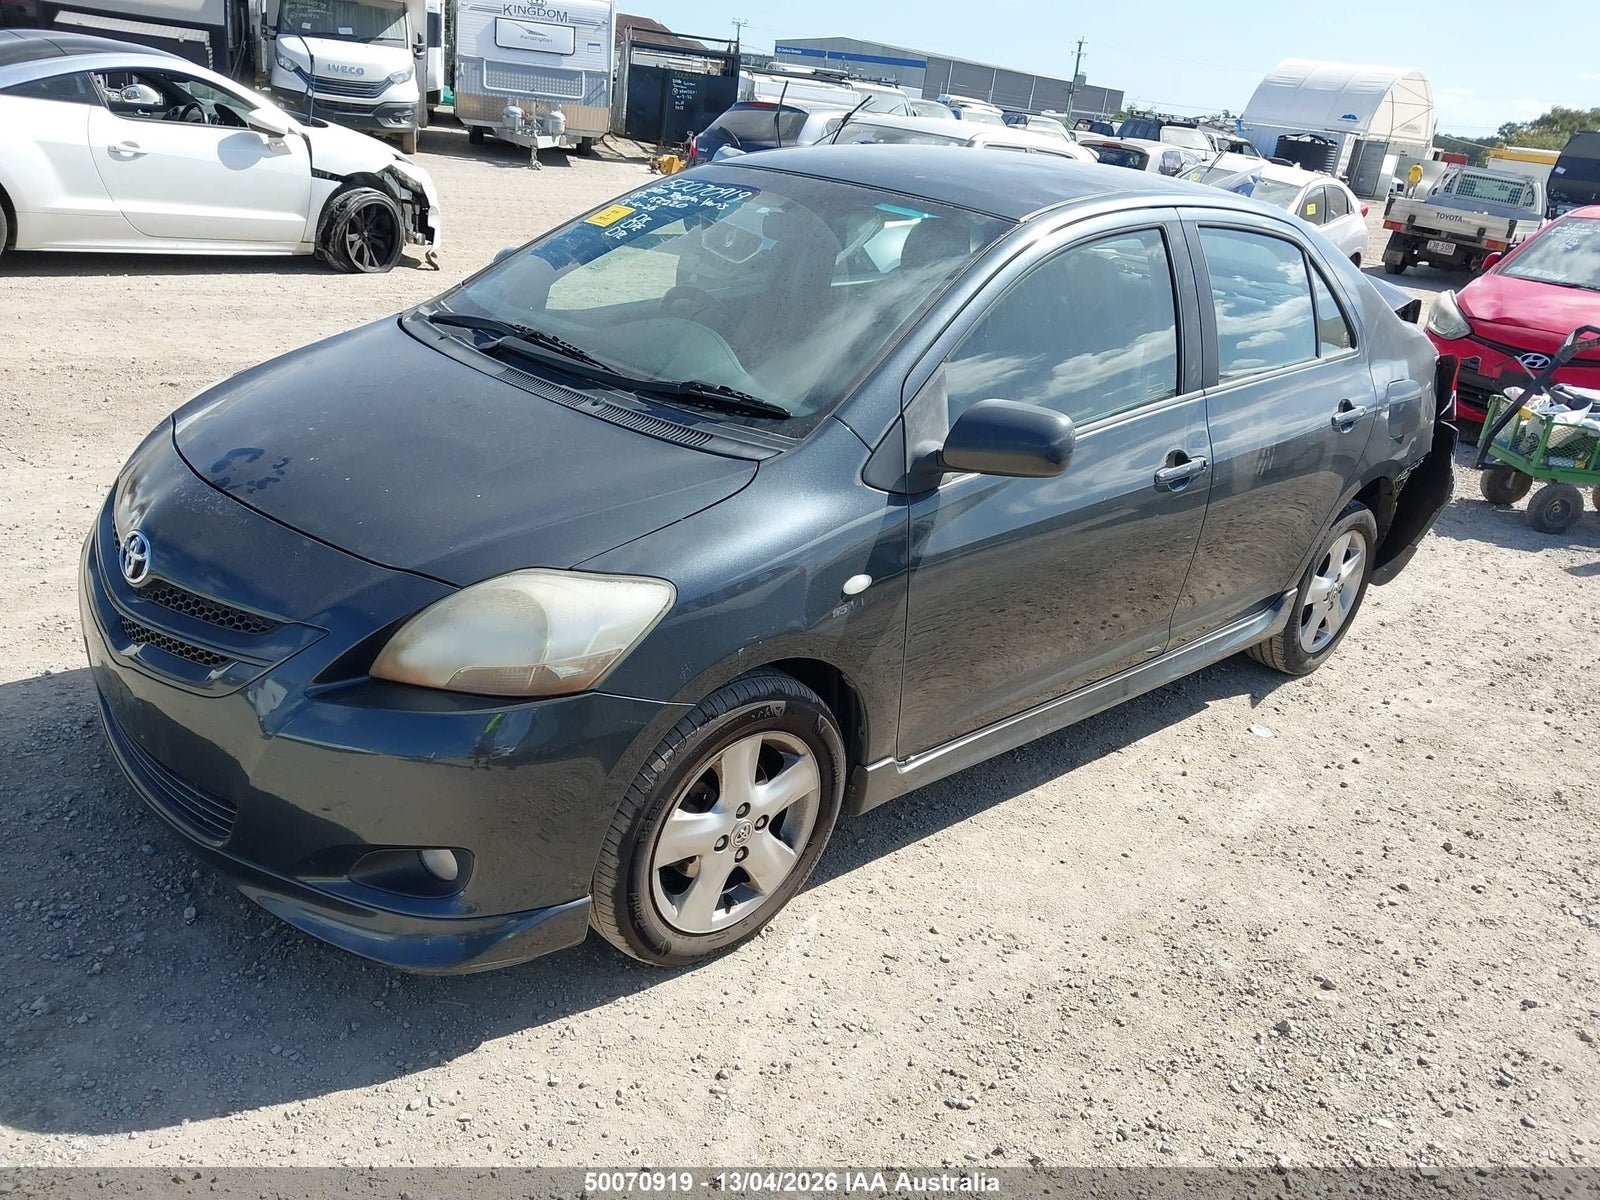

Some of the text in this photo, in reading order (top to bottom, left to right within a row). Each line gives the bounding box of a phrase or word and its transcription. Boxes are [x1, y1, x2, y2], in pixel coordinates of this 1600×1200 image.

[503, 4, 568, 23] KINGDOM
[328, 63, 364, 76] IVECO
[662, 178, 752, 202] 50070919
[1436, 212, 1463, 222] TOYOTA
[627, 889, 650, 931] Rapid
